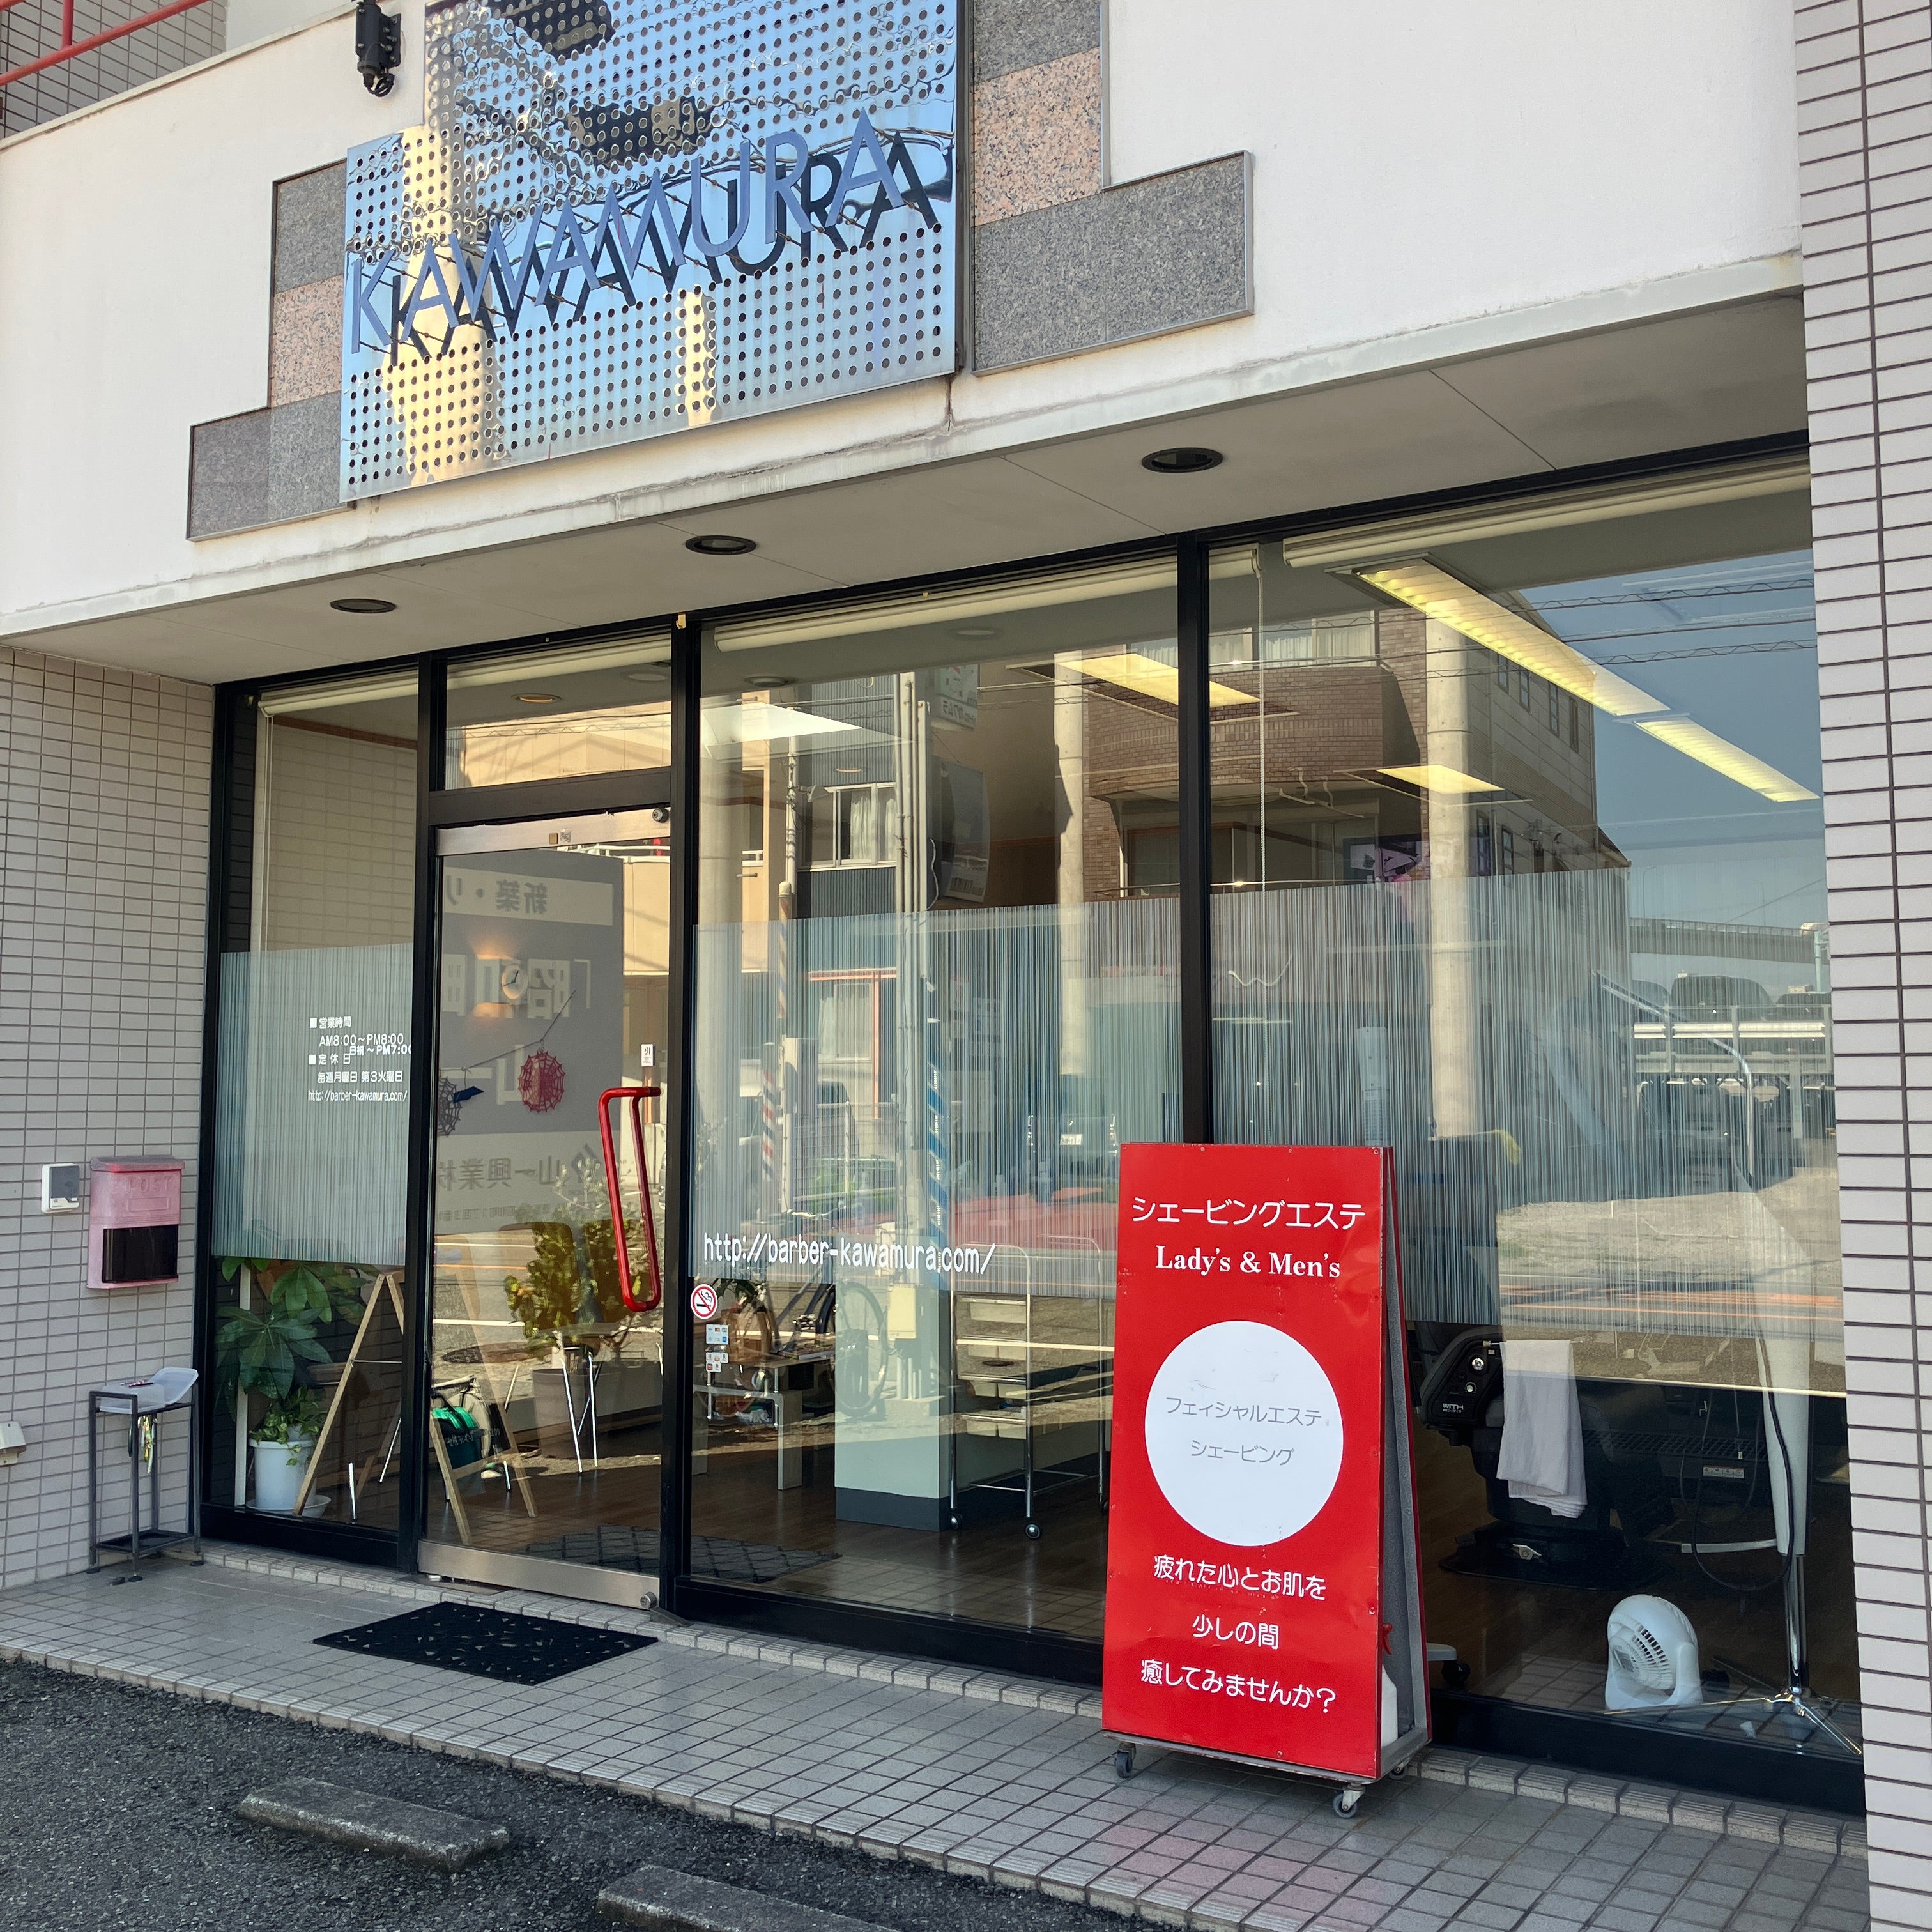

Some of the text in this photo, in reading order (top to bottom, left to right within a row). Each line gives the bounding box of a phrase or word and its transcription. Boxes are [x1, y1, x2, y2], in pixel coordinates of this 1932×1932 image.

[351, 108, 905, 355] KAWAMURA
[319, 1016, 351, 1029] 営業時間
[317, 1070, 403, 1084] 毎週月曜日 第3火曜日
[307, 1089, 408, 1101] http://barber-kawamura.com/
[127, 1175, 174, 1193] POST
[1132, 1197, 1365, 1230] シェービングエステ
[703, 1232, 995, 1275] http://barber-kawamura.com/
[1155, 1245, 1341, 1278] Lady's & Men's
[1190, 1439, 1295, 1466] シェービング
[1153, 1554, 1327, 1600] 疲れた心とお肌を
[1192, 1614, 1280, 1650] 少しの間
